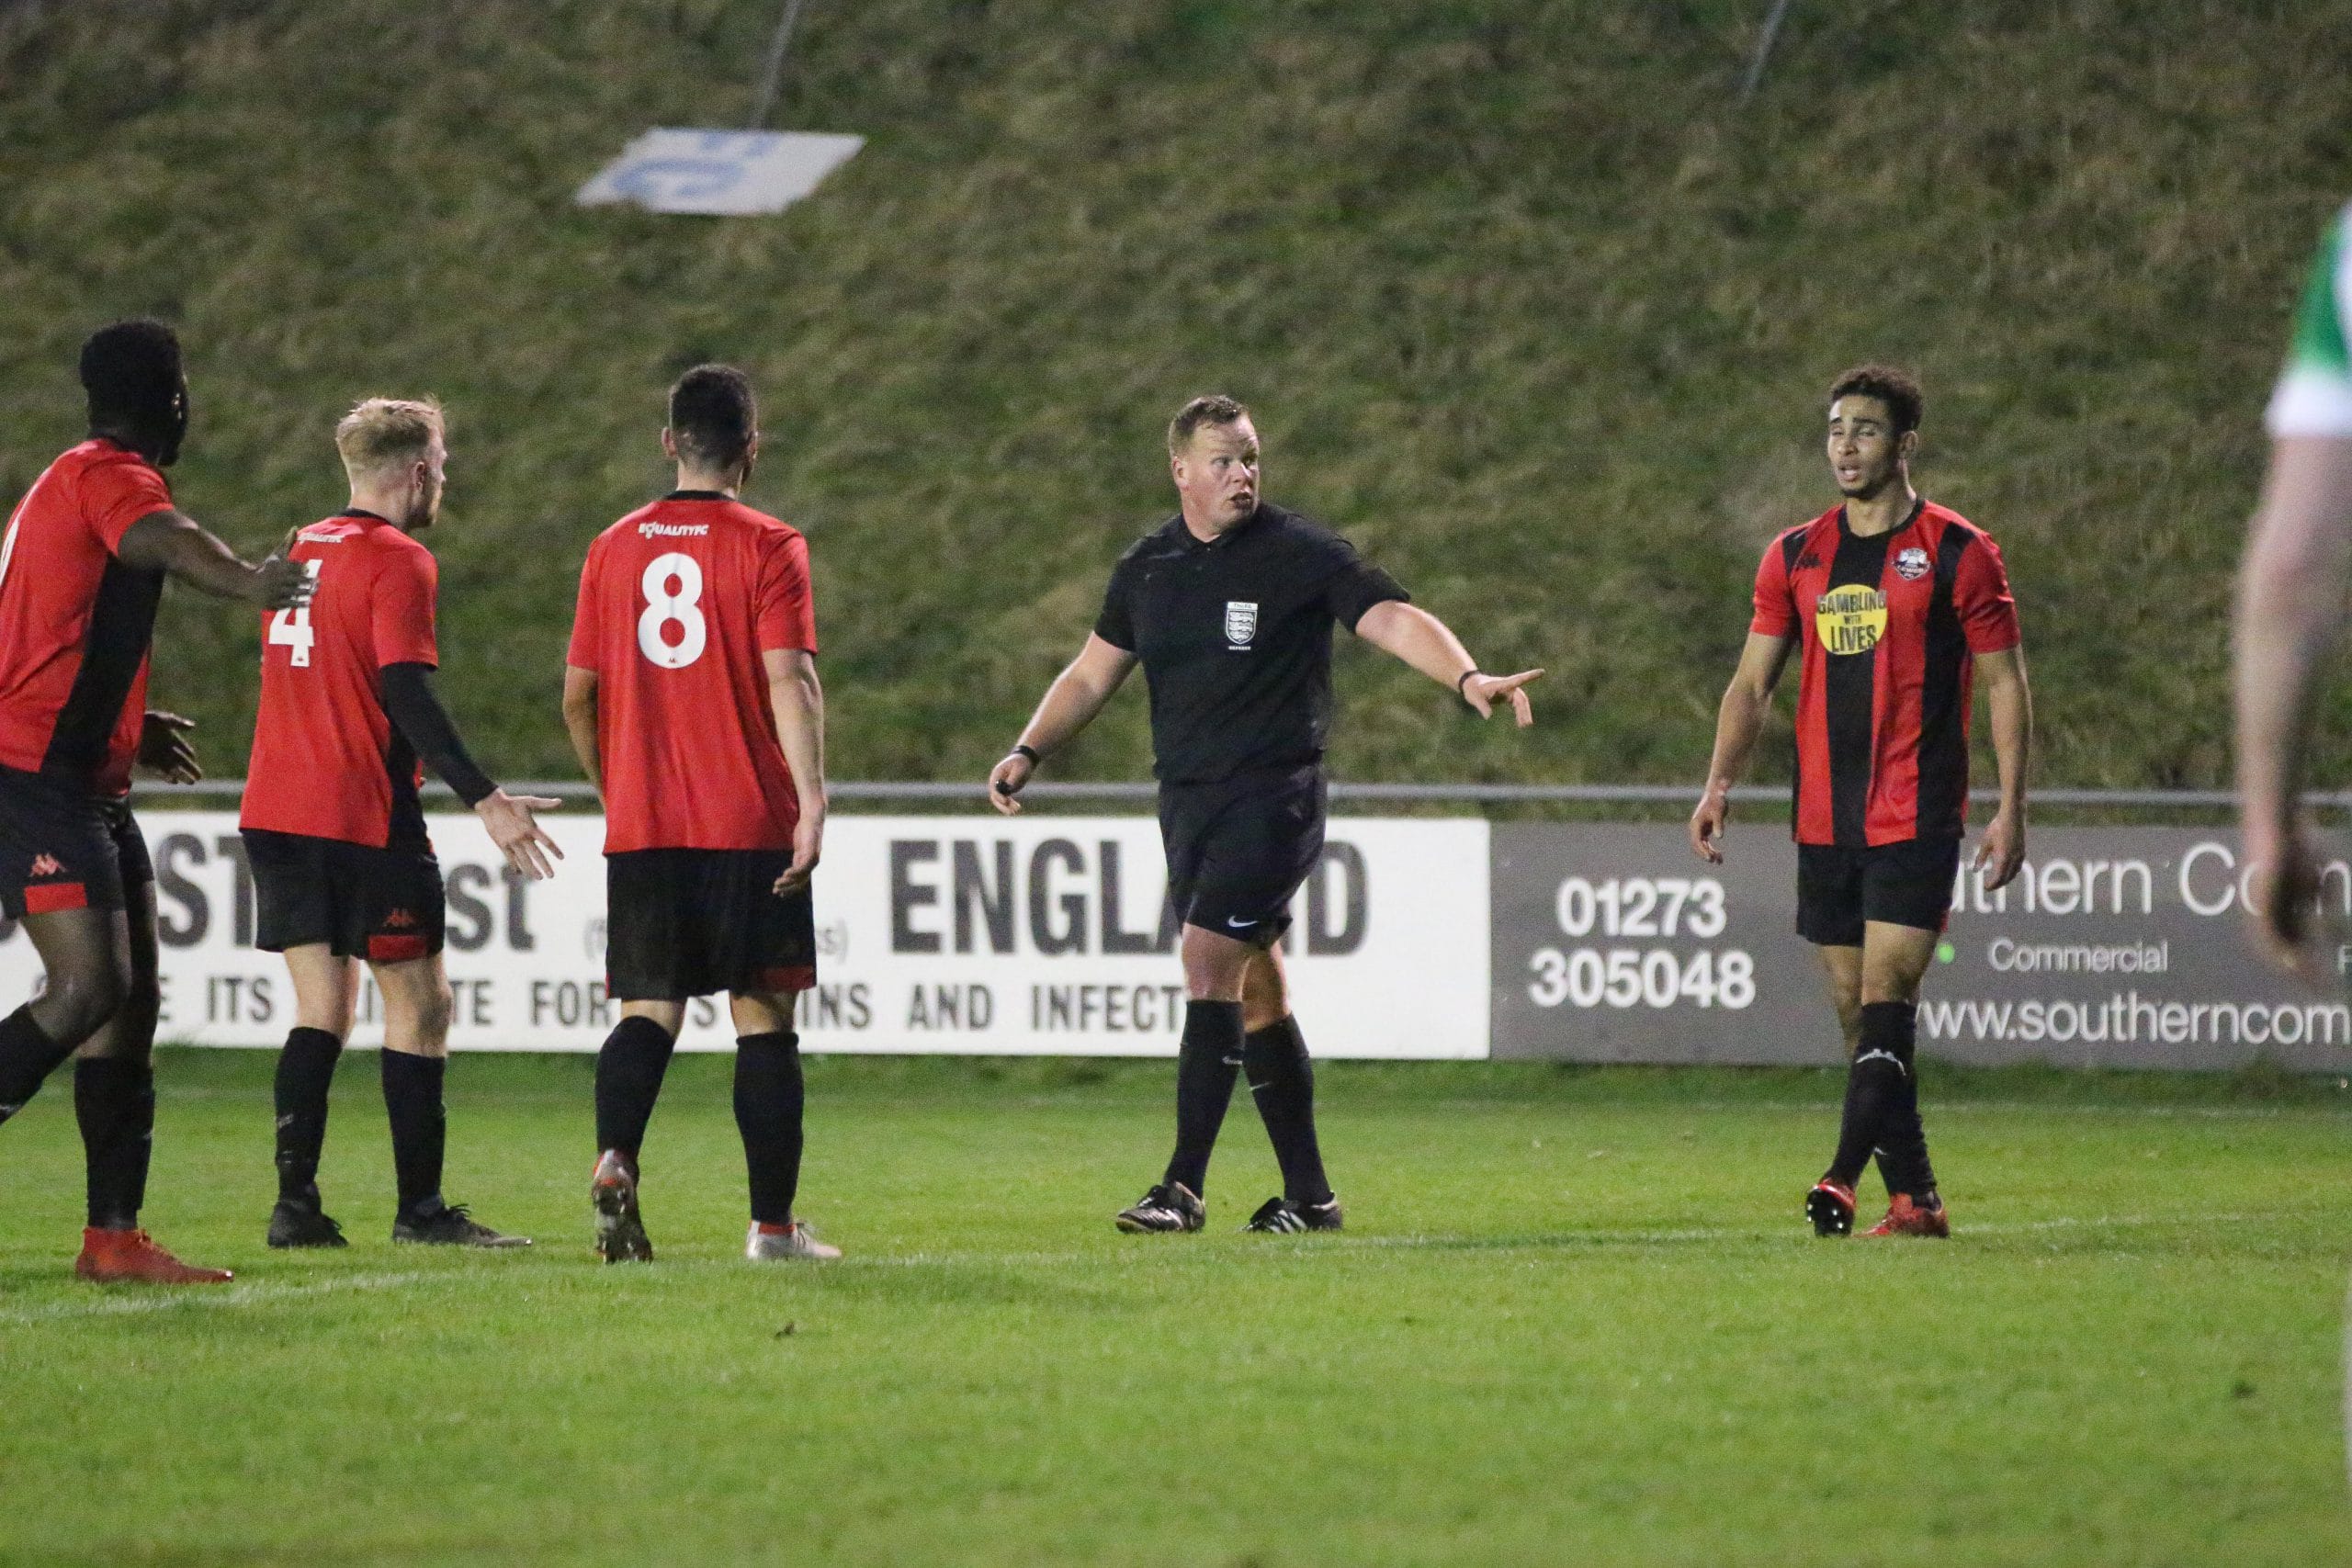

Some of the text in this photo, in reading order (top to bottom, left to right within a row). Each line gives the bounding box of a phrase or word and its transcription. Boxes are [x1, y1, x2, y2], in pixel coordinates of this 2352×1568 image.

[268, 558, 323, 668] 4
[638, 552, 707, 669] 8
[1816, 589, 1888, 616] GAMBLING
[1830, 624, 1878, 652] LIVES
[889, 839, 1369, 956] ENGLD
[1558, 876, 1727, 939] 01273
[1529, 947, 1756, 1010] 305048
[1987, 938, 2169, 974] Commercial
[208, 976, 273, 1023] ITS
[528, 980, 610, 1028] FOR
[905, 985, 993, 1032] AND
[1031, 984, 1184, 1033] INFECT
[1916, 989, 2351, 1045] ww.southerncom
